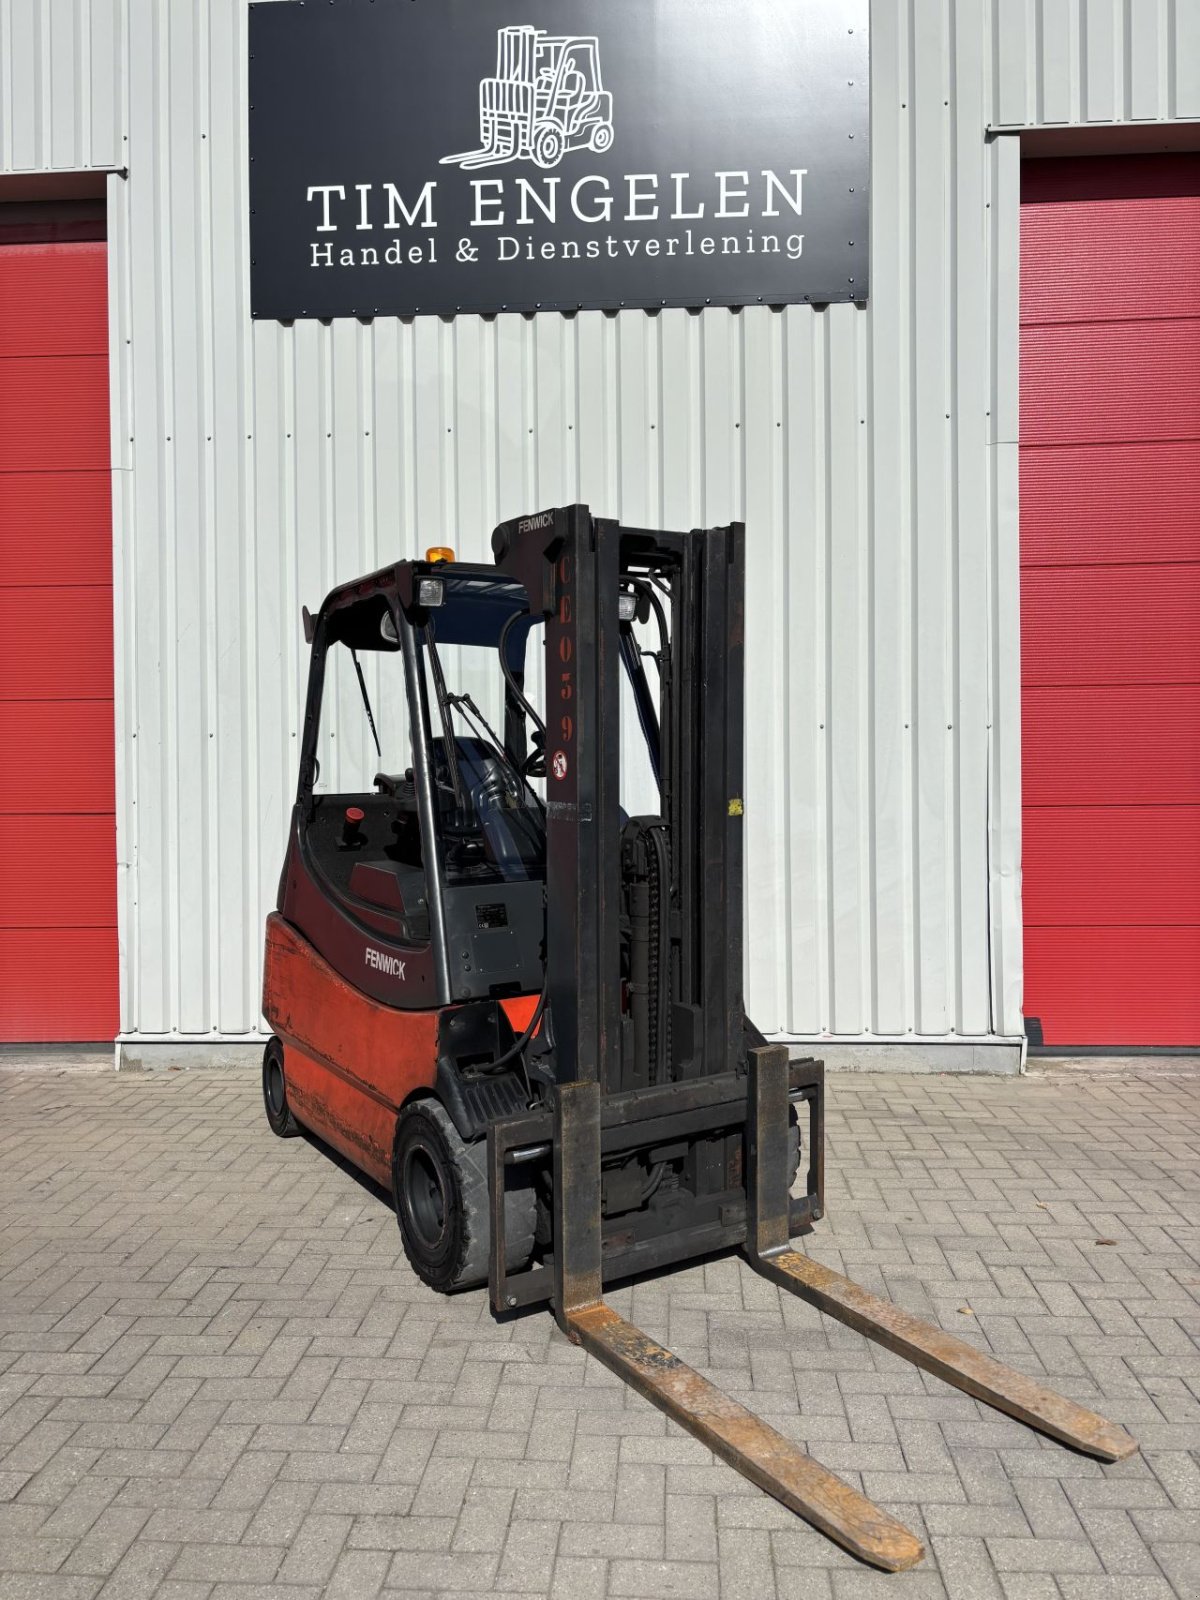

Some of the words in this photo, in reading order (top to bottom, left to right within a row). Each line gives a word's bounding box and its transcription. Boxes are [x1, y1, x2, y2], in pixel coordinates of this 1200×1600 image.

[306, 181, 438, 232] TIM
[469, 168, 808, 227] ENGELEN
[310, 238, 438, 267] Handel
[455, 237, 479, 263] &
[497, 228, 806, 260] Dienstverlening
[518, 511, 554, 535] FENWICK
[365, 947, 406, 981] FENWICK
